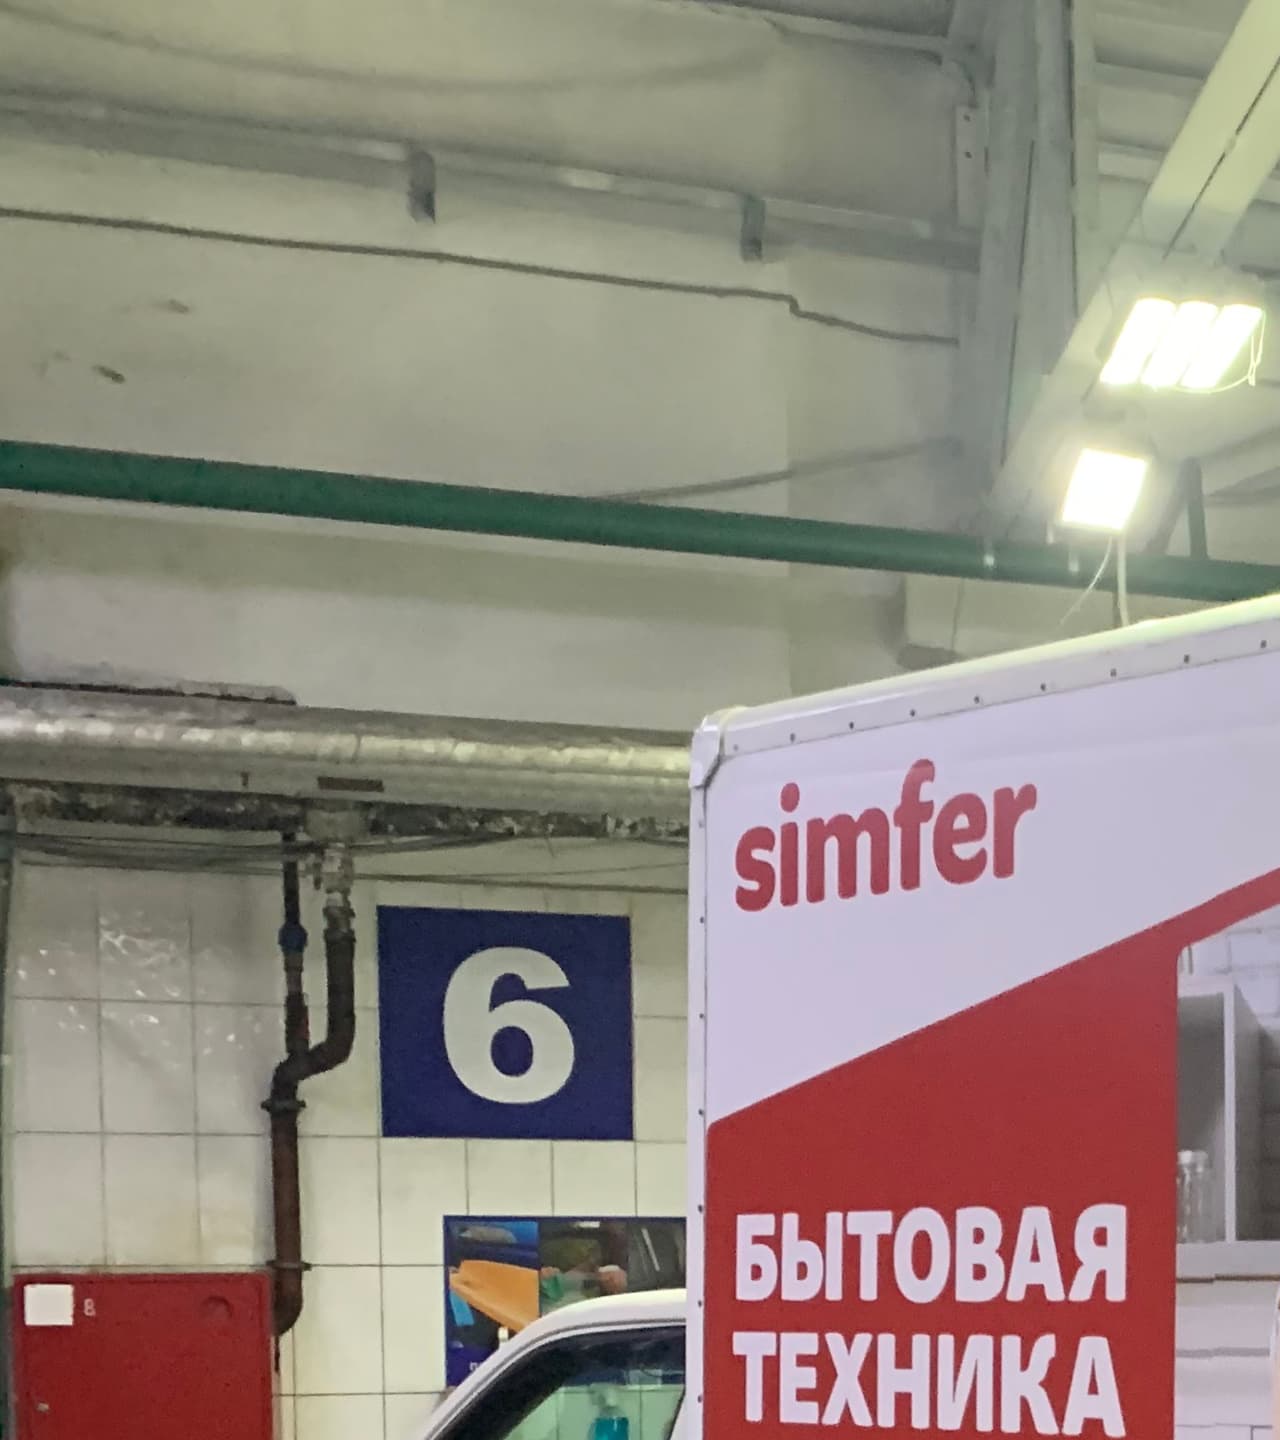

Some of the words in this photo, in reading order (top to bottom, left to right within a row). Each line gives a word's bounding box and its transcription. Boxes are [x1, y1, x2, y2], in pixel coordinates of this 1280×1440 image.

[735, 758, 1038, 912] simfer
[443, 946, 575, 1104] 6
[735, 1203, 1127, 1303] БЫТОВАЯ
[732, 1331, 1127, 1438] ТЕХНИКА
